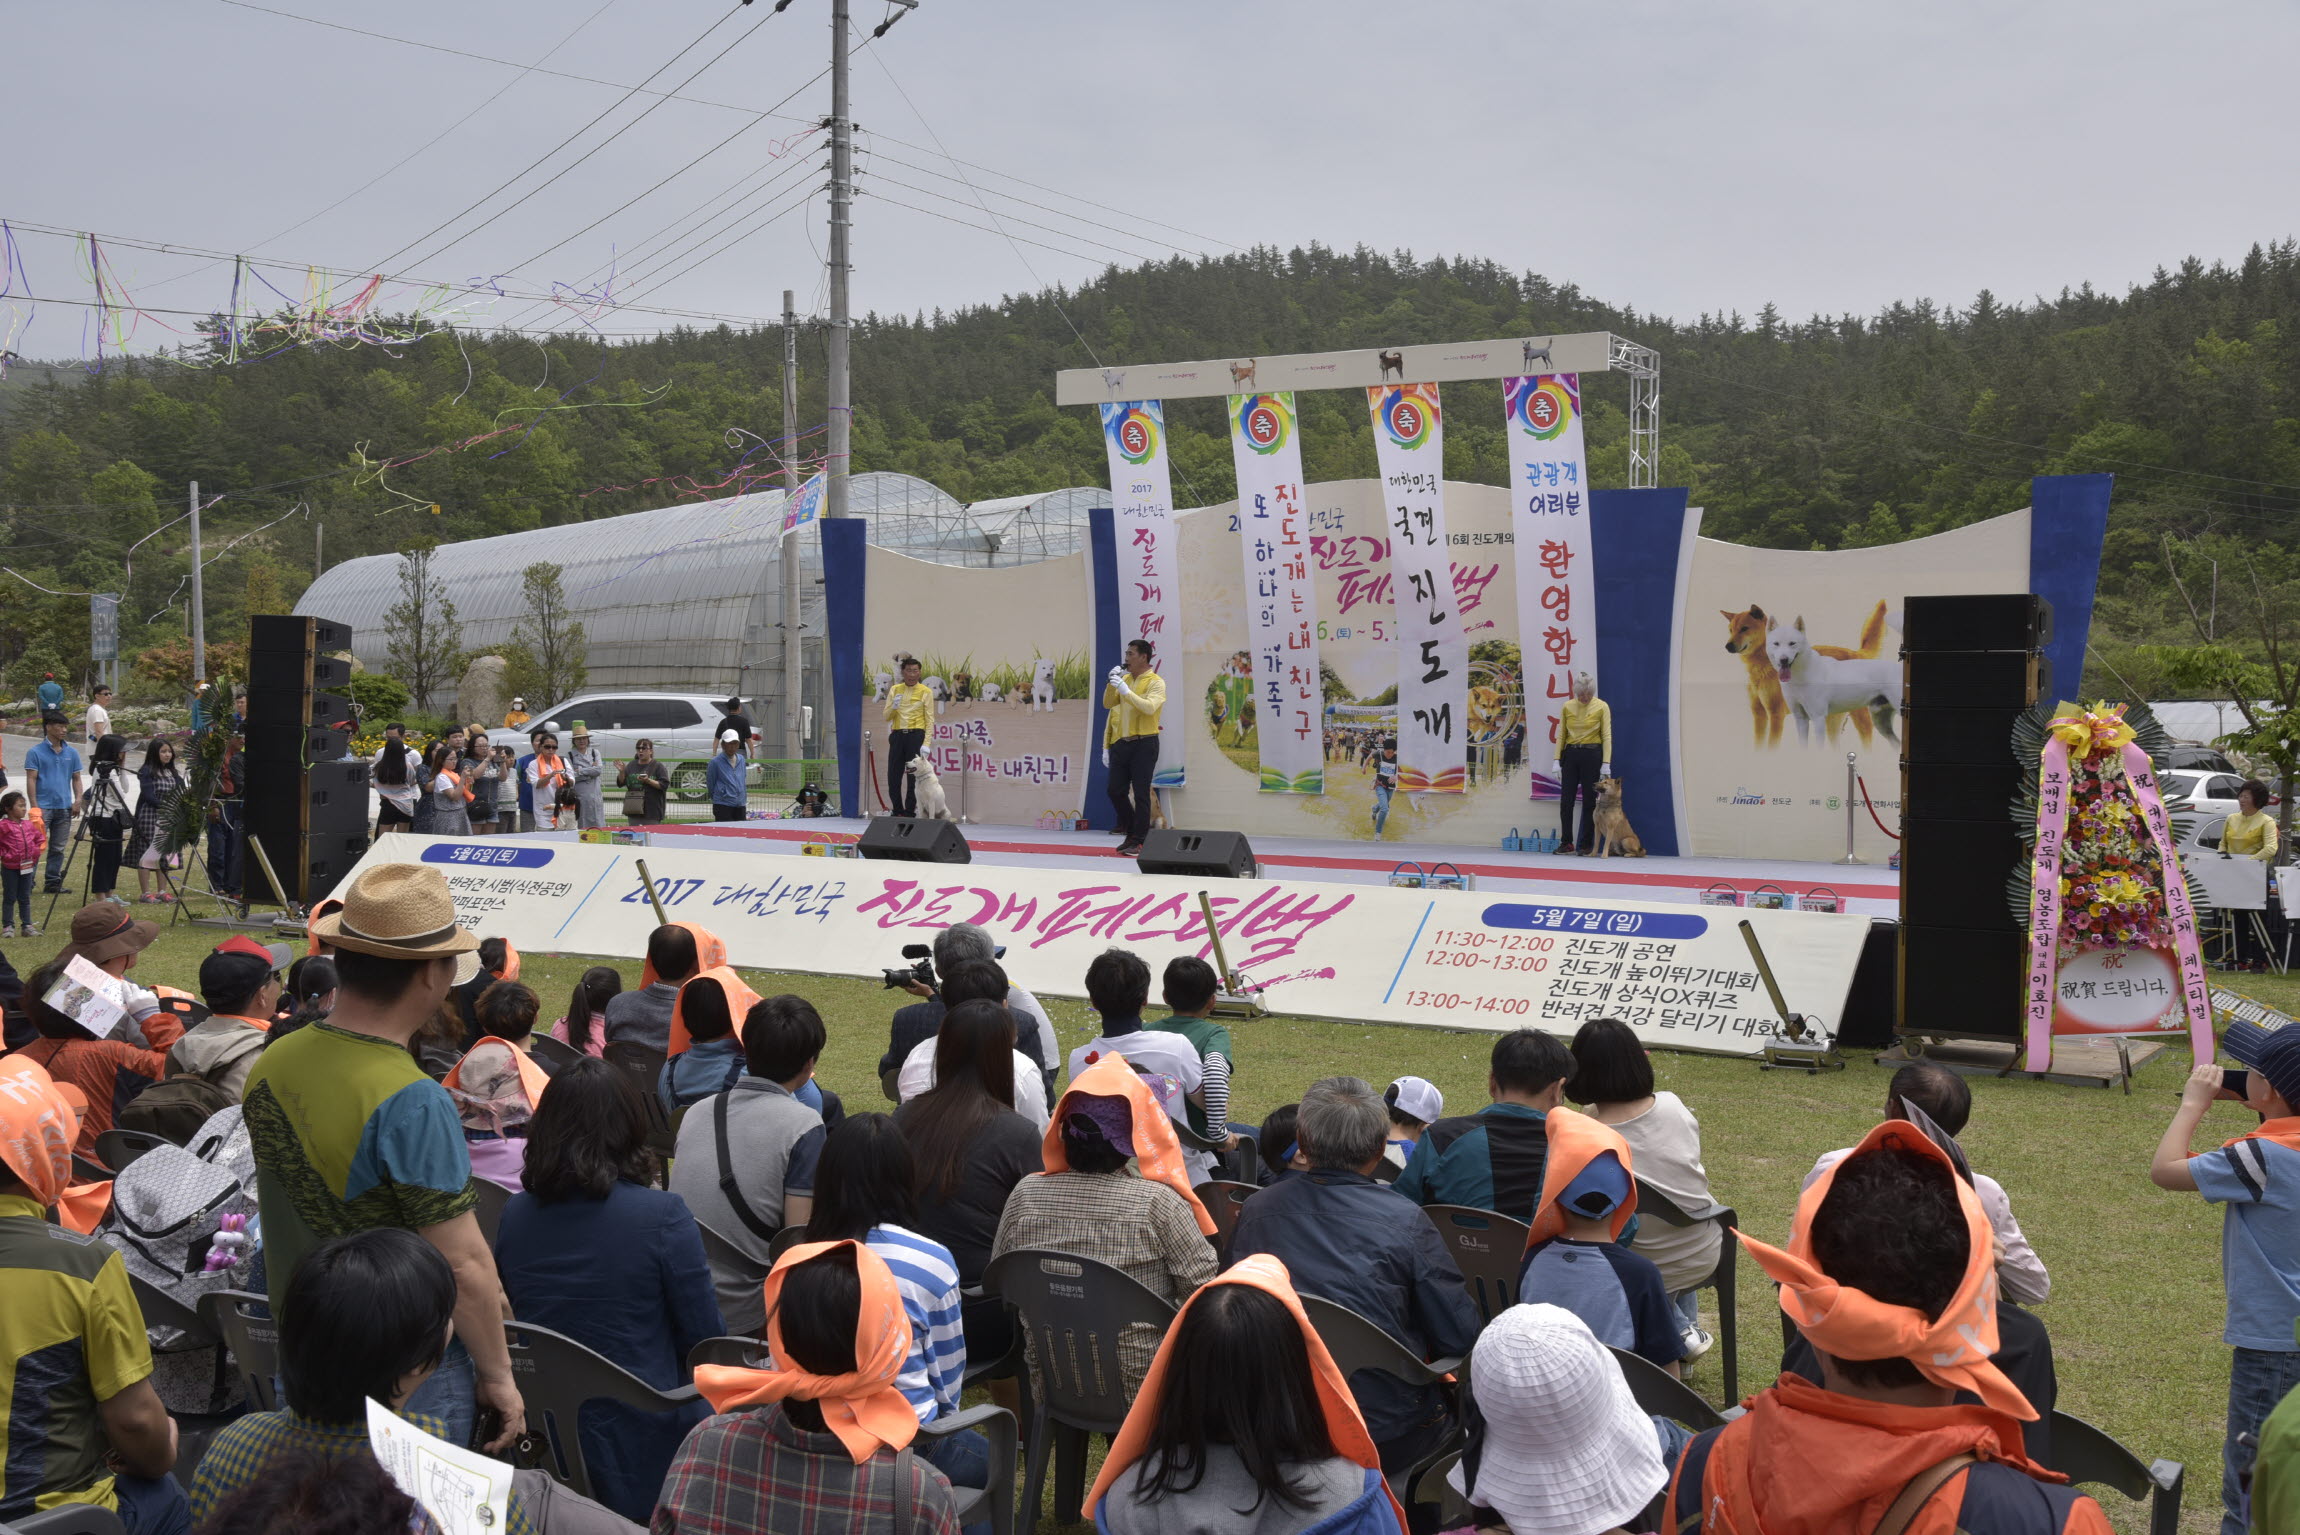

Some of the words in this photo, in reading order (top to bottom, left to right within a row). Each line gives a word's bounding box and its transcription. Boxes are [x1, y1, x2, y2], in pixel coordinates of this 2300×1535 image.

[1398, 409, 1416, 433] 축
[1533, 398, 1553, 423] 축
[1127, 427, 1143, 449] 축
[1254, 415, 1272, 438] 축
[1388, 471, 1438, 495] 대한민국
[1525, 460, 1578, 488] 관광객
[1131, 484, 1152, 494] 2017
[1122, 504, 1165, 519] 대한민국
[1529, 490, 1582, 517] 여러분
[1394, 506, 1438, 546] 국견
[1253, 494, 1270, 519] 또
[1263, 649, 1284, 718] 가족
[1408, 568, 1451, 744] 진도개
[2043, 771, 2063, 815] 보배섬
[2133, 773, 2154, 789] 祝
[450, 846, 476, 861] 5월
[471, 848, 496, 863] 6일
[492, 849, 519, 864] (토)
[2037, 829, 2056, 873] 진도개
[448, 876, 489, 892] 반려견
[620, 876, 706, 906] 2017
[712, 875, 846, 925] 대한민국
[2148, 804, 2174, 869] 대한민국
[2168, 886, 2191, 933] 진도개
[2184, 953, 2207, 1020] 페스티벌
[1531, 908, 1567, 927] 5월
[1569, 910, 1604, 931] 7일
[1606, 912, 1643, 933] (일)
[2035, 888, 2054, 948] 영농조합
[1434, 929, 1555, 953] 11:30~12:00
[1564, 937, 1630, 960] 진도개
[1632, 942, 1677, 962] 공연
[1425, 949, 1548, 973] 12:00~13:00
[1558, 957, 1624, 980] 진도개
[2036, 951, 2048, 969] 대표
[2101, 952, 2124, 970] 祝
[1548, 978, 1614, 1001] 진도개
[1616, 983, 1739, 1011] 상식OX퀴즈
[2030, 973, 2049, 1020] 이호진
[2061, 980, 2097, 1000] 祝賀
[2101, 978, 2169, 998] 드립니다.
[1405, 990, 1531, 1016] 13:00~14:00
[1540, 999, 1606, 1024] 반려견
[1609, 1005, 1656, 1026] 건강
[1659, 1008, 1728, 1035] 달리기
